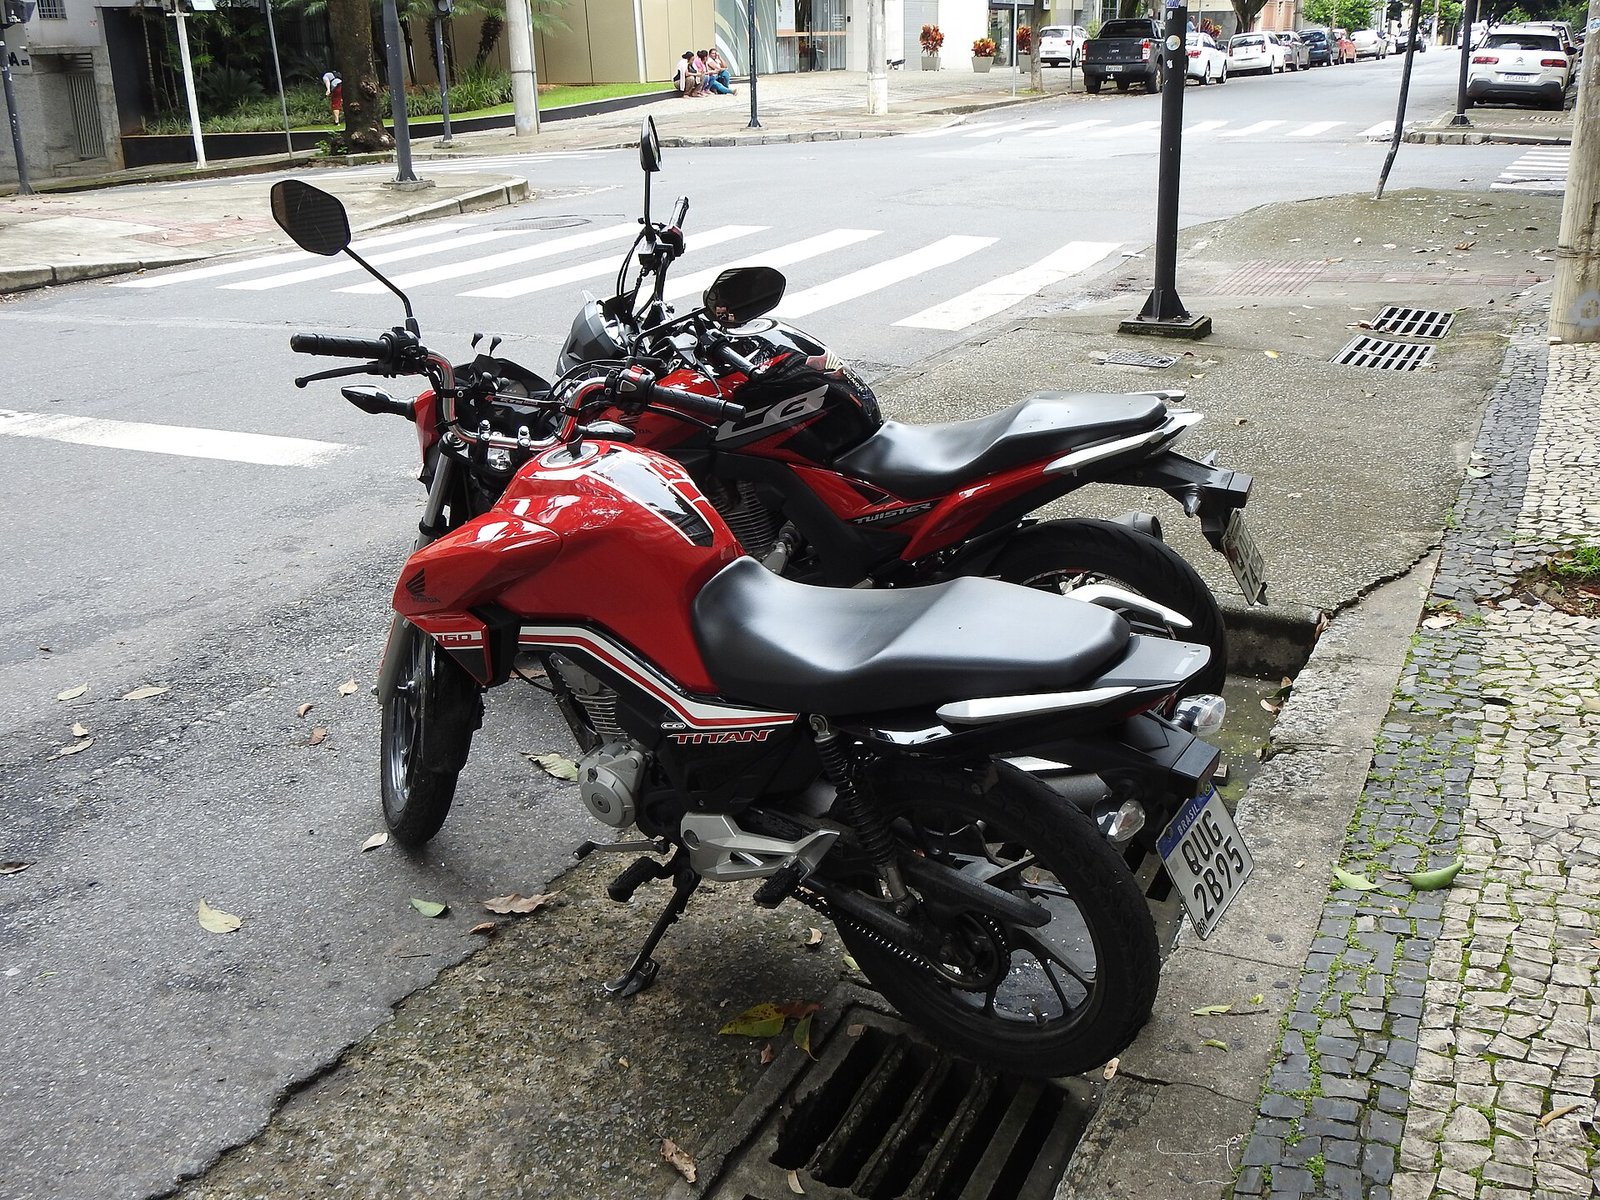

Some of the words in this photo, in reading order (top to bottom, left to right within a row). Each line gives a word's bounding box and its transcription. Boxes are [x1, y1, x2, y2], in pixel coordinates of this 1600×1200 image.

[854, 503, 932, 524] TWISTER
[667, 729, 775, 744] TITAN
[1177, 803, 1200, 836] BRASIL
[1181, 809, 1224, 876] QUG
[1193, 835, 1244, 922] 2B95
[1197, 917, 1208, 935] BR
